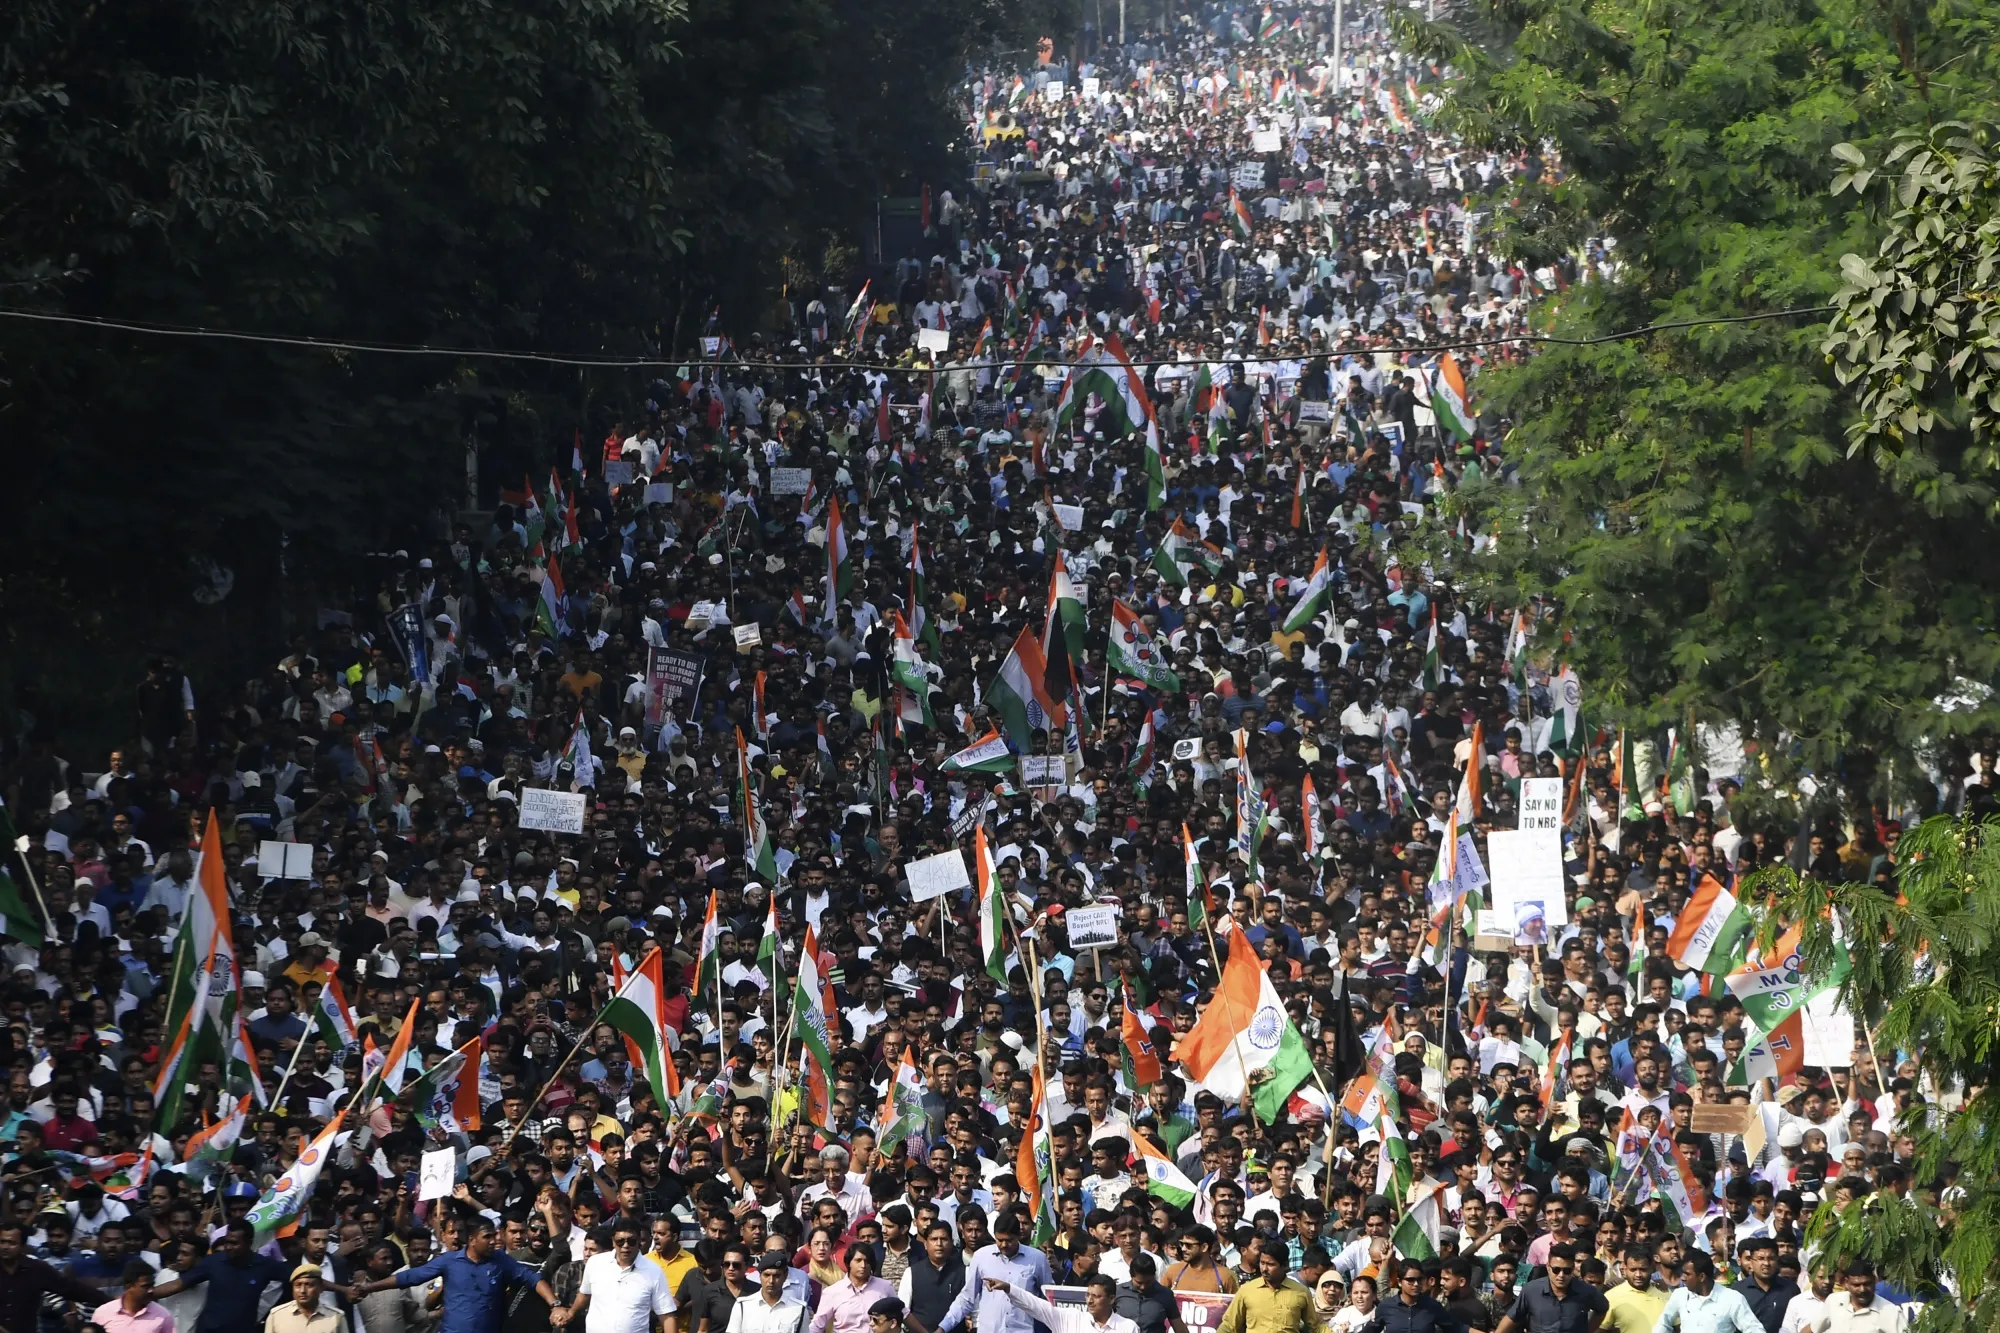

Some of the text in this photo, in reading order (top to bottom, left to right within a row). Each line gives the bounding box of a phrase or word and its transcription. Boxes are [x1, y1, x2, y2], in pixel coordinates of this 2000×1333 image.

[657, 655, 698, 671] READY TO DIE
[656, 664, 668, 672] BUT
[677, 667, 696, 678] READY
[527, 792, 559, 805] INDIA
[1524, 798, 1557, 811] SAY NO
[543, 812, 561, 820] CARE
[951, 812, 971, 833] READY
[1523, 816, 1557, 829] TO NRC
[1072, 920, 1095, 930] Boycott
[1073, 914, 1092, 923] Reject
